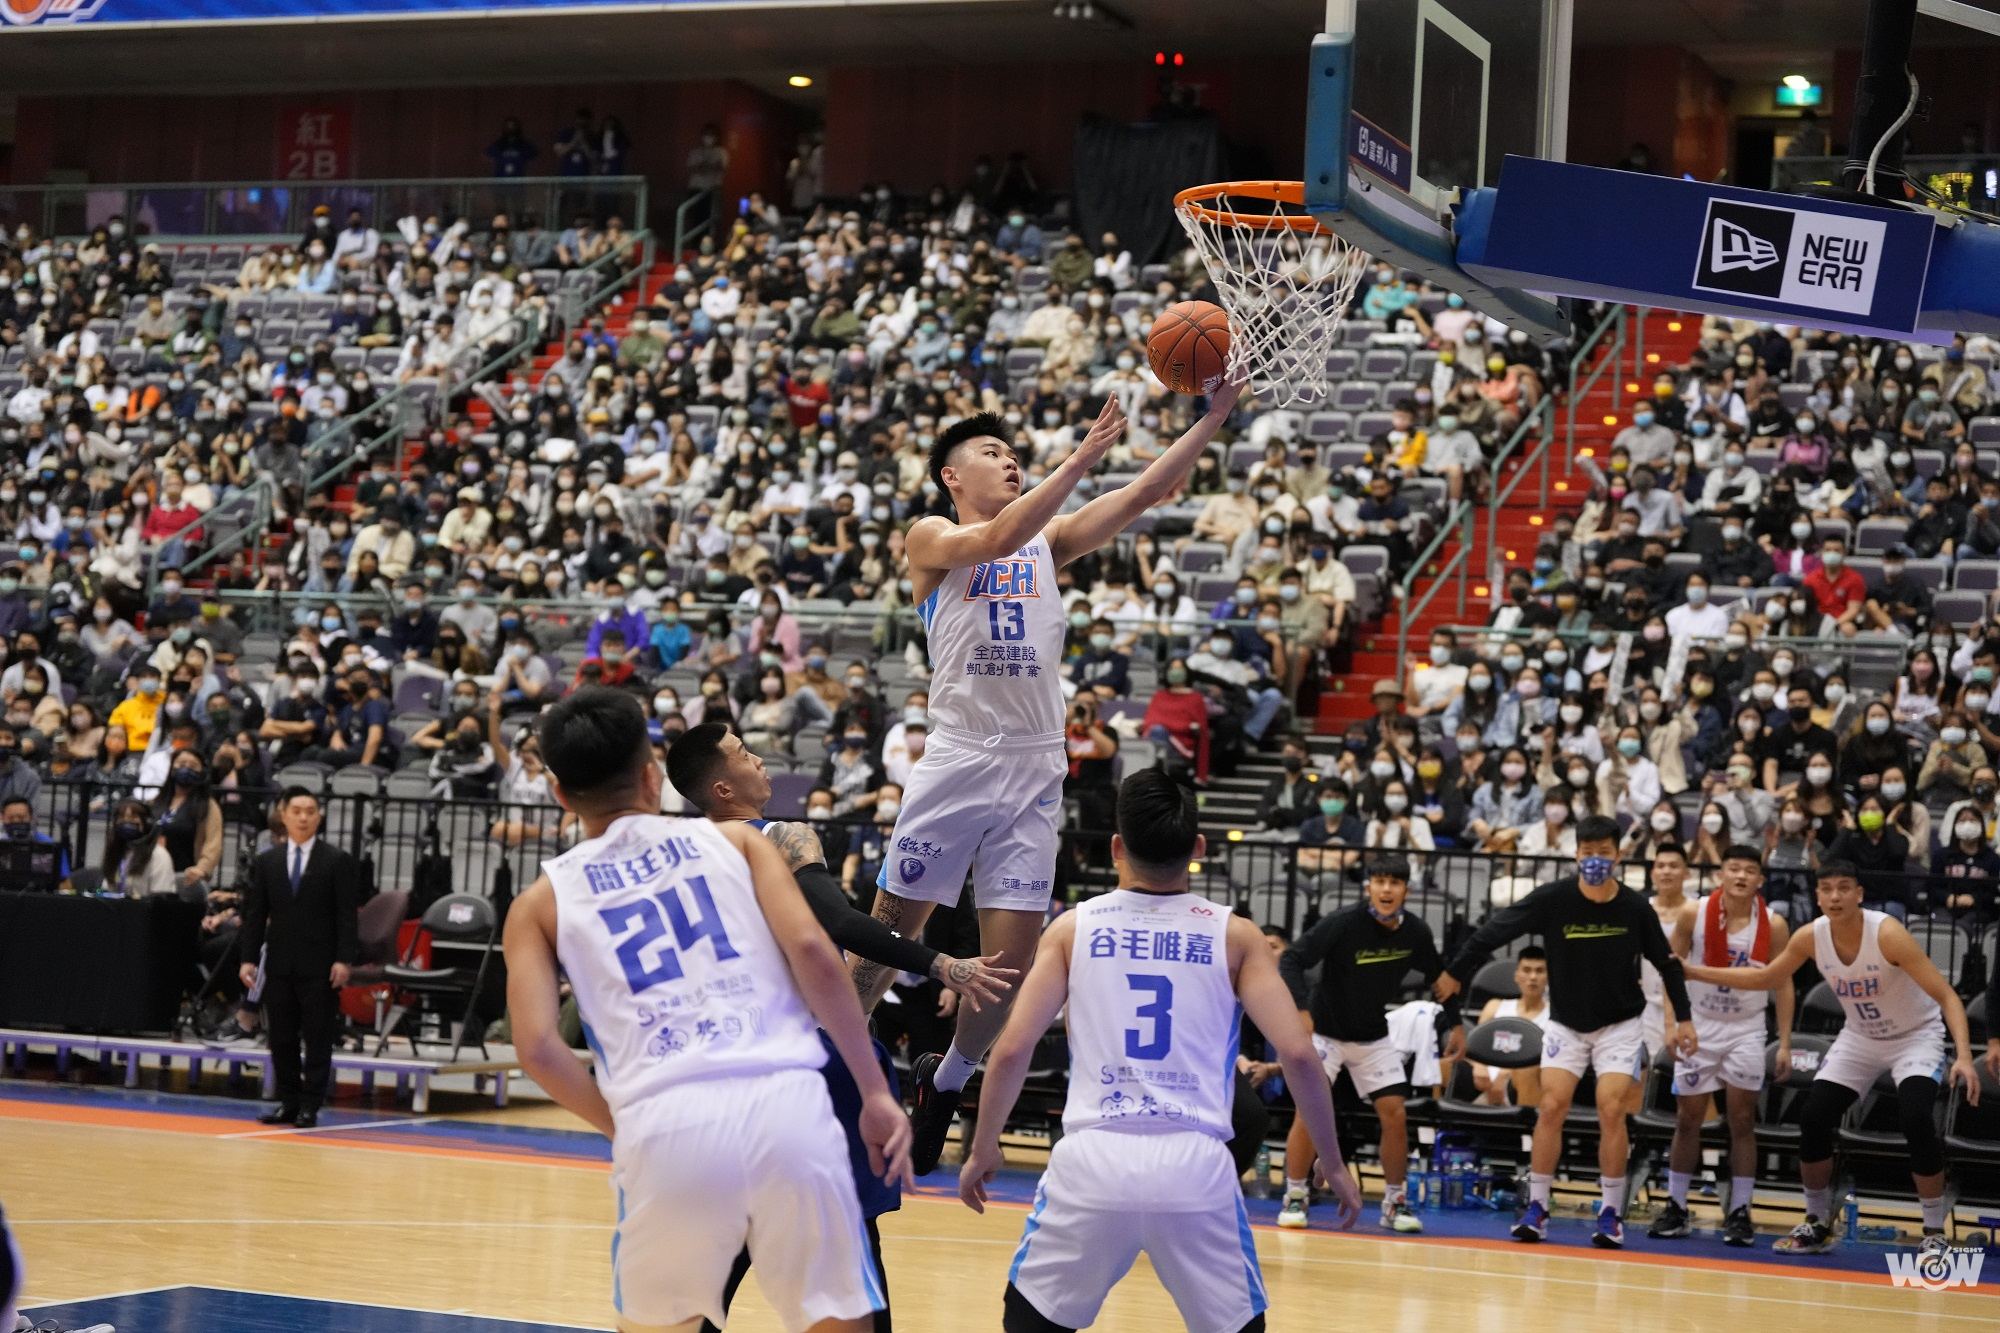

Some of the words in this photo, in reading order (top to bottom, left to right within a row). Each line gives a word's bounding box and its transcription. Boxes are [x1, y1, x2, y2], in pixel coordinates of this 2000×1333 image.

[296, 112, 334, 147] 紅
[288, 150, 337, 178] 2B
[1803, 233, 1868, 265] NEW
[1799, 260, 1862, 292] ERA
[988, 601, 1025, 641] 13
[974, 645, 1037, 662] 全茂建設
[966, 662, 1041, 678] 凱創實業
[597, 875, 741, 995] 24
[1090, 927, 1214, 965] 谷毛唯嘉
[1836, 977, 1879, 998] UCH
[1125, 974, 1174, 1061] 3
[1854, 1003, 1881, 1020] 15
